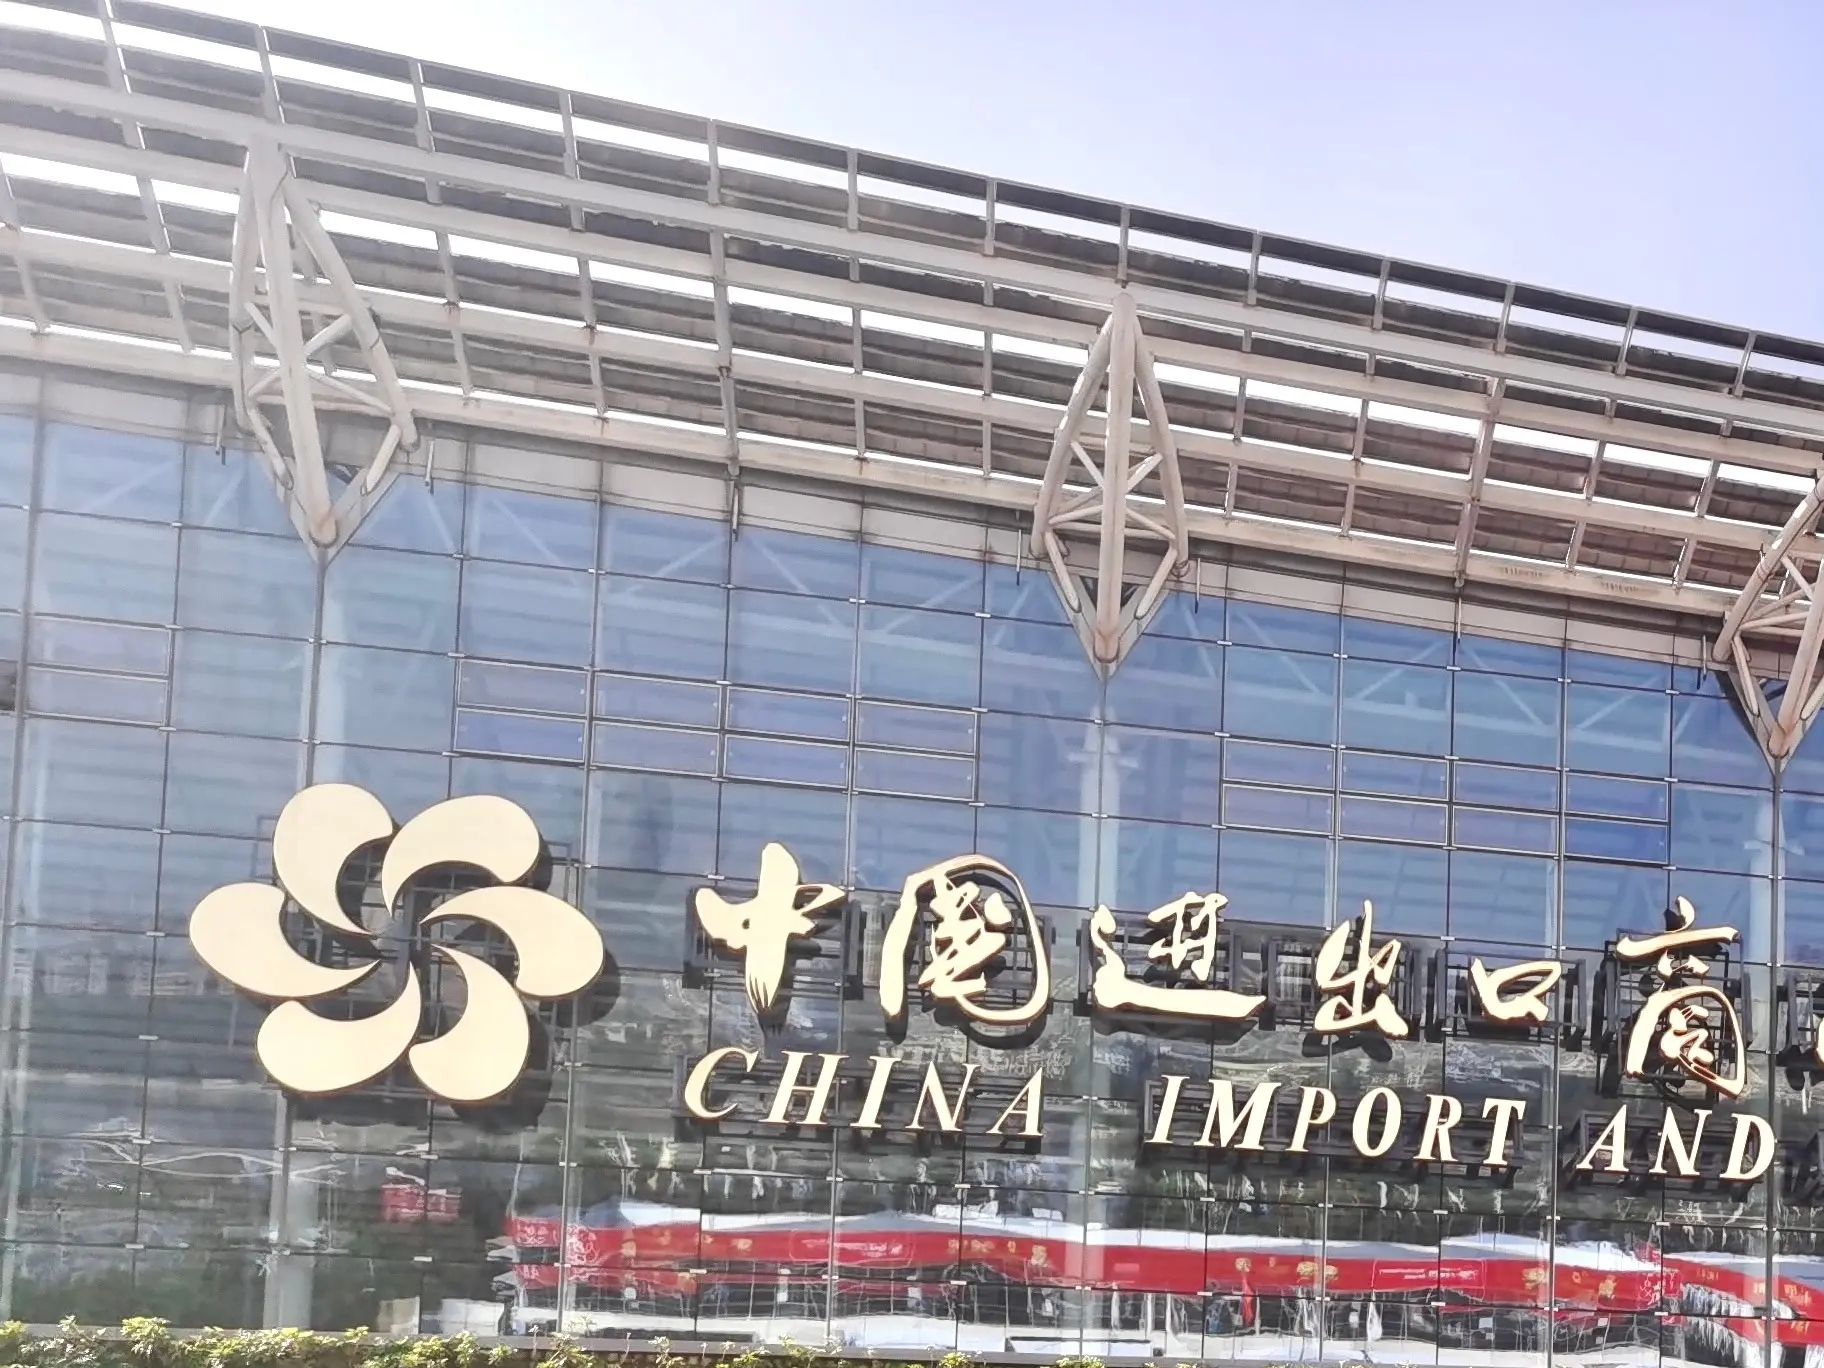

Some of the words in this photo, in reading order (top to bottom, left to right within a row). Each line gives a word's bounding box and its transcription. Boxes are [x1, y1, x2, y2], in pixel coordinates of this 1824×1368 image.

[683, 1046, 1046, 1139] CHINA
[1144, 1074, 1528, 1168] IMPORT
[1576, 1103, 1777, 1182] AND
